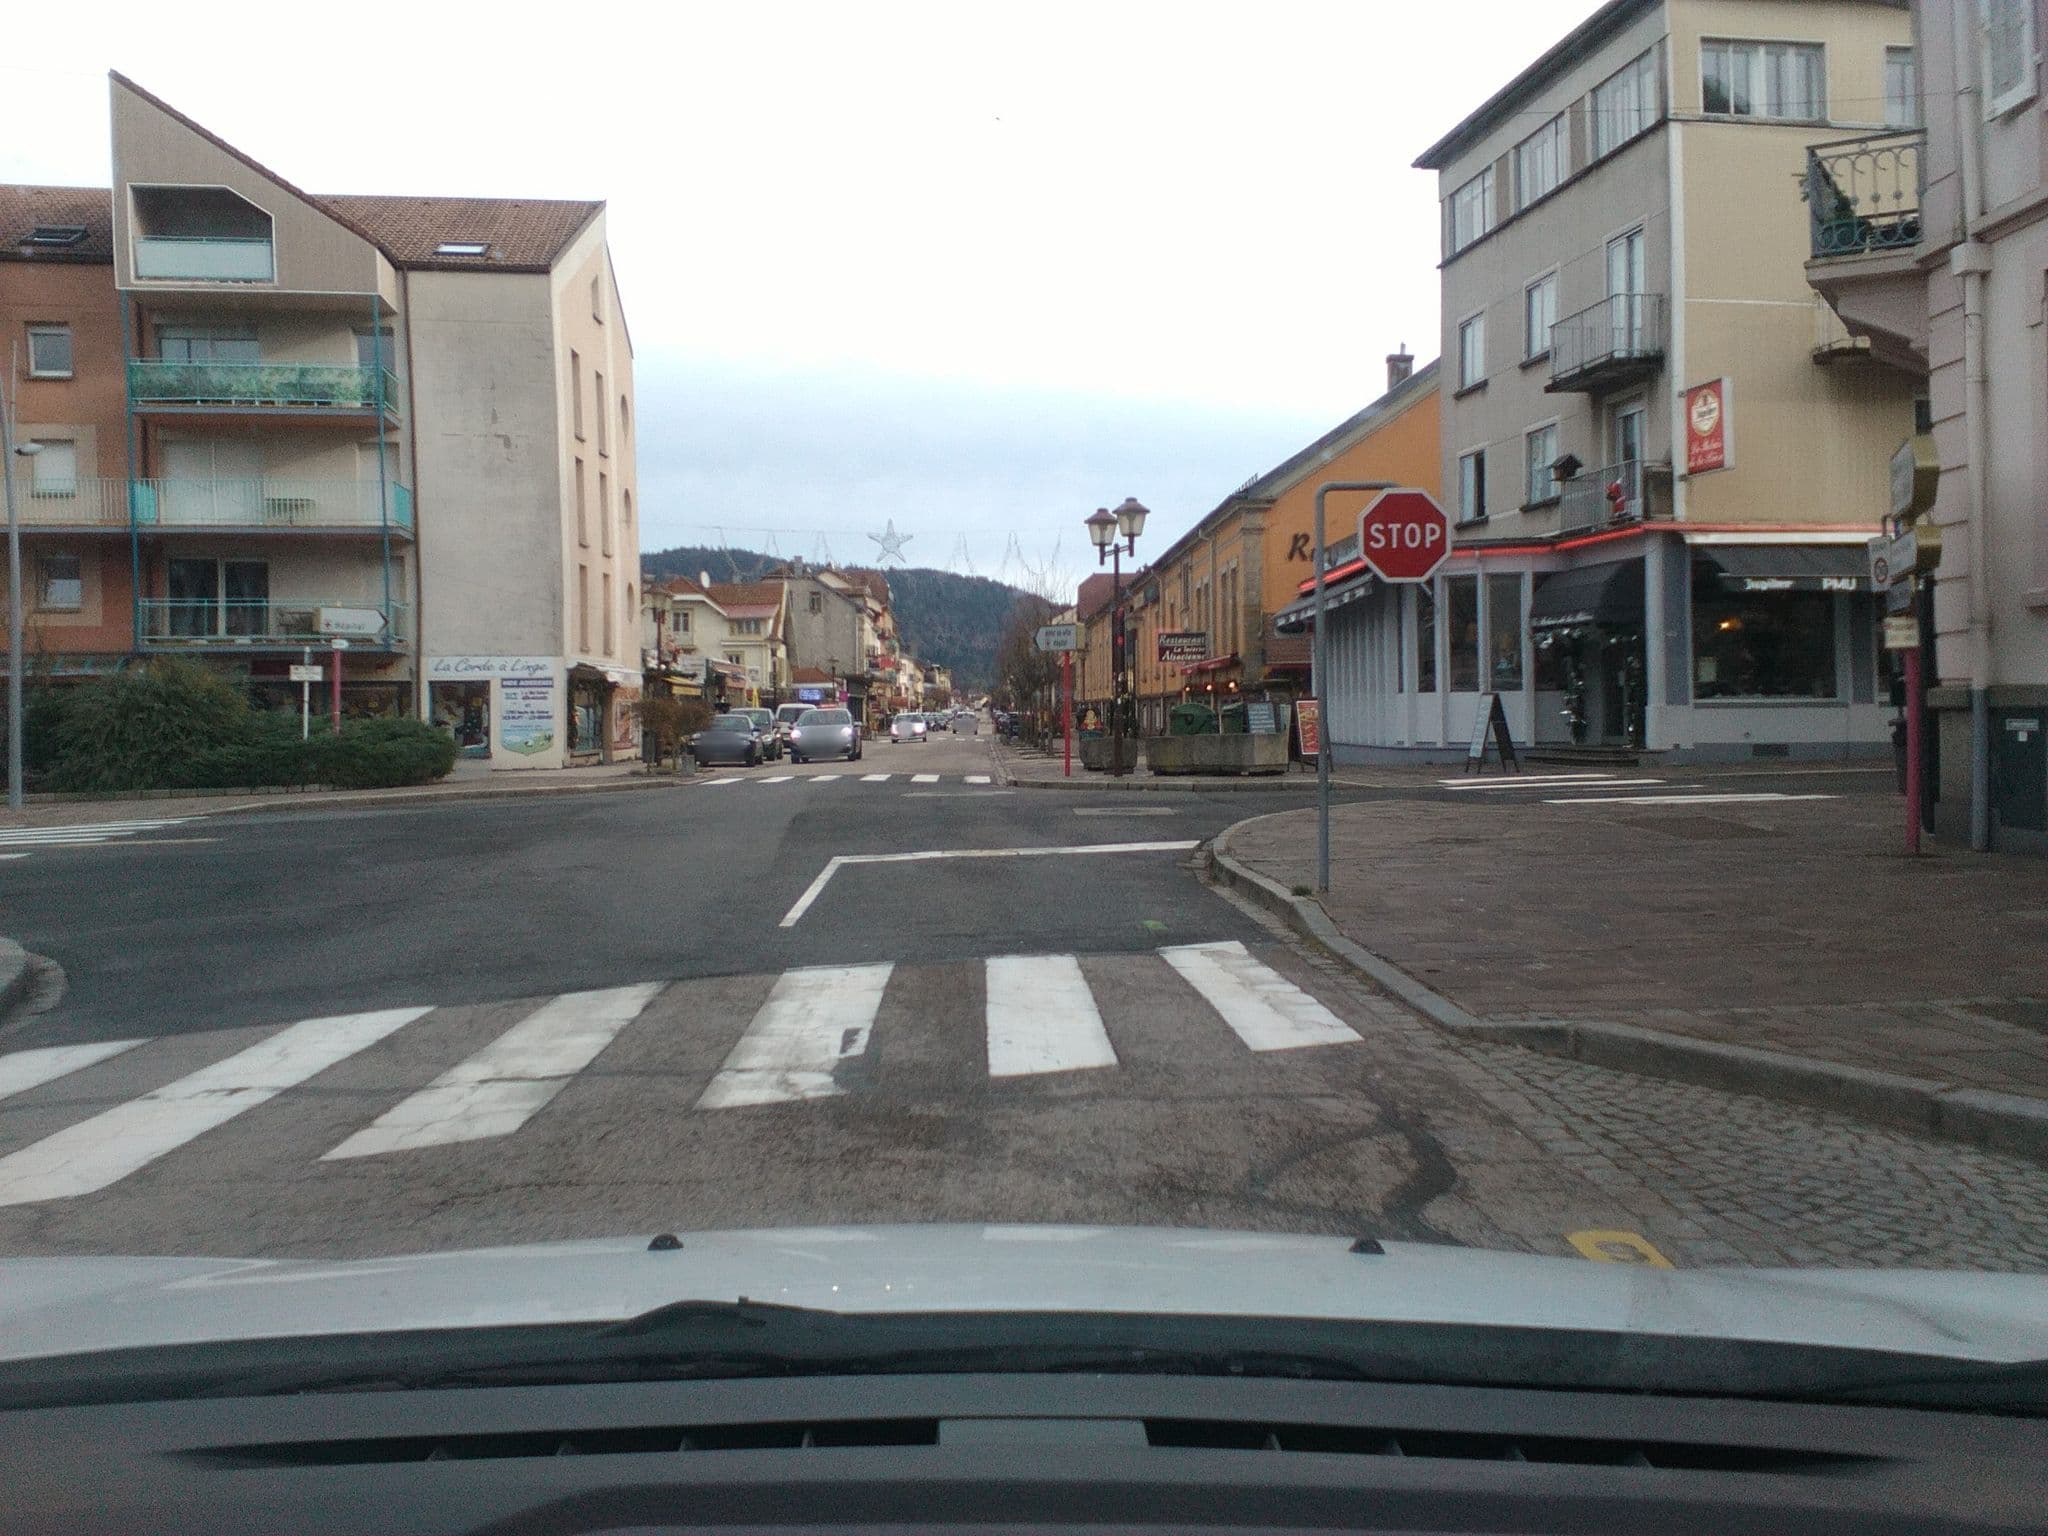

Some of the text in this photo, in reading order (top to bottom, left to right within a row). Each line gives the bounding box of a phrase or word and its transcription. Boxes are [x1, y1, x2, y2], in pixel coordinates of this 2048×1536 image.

[1369, 522, 1441, 549] STOP
[1822, 577, 1857, 591] PMU
[1159, 634, 1206, 645] Restaurant
[434, 658, 450, 673] La
[454, 657, 494, 673] Corde
[499, 658, 508, 672] à
